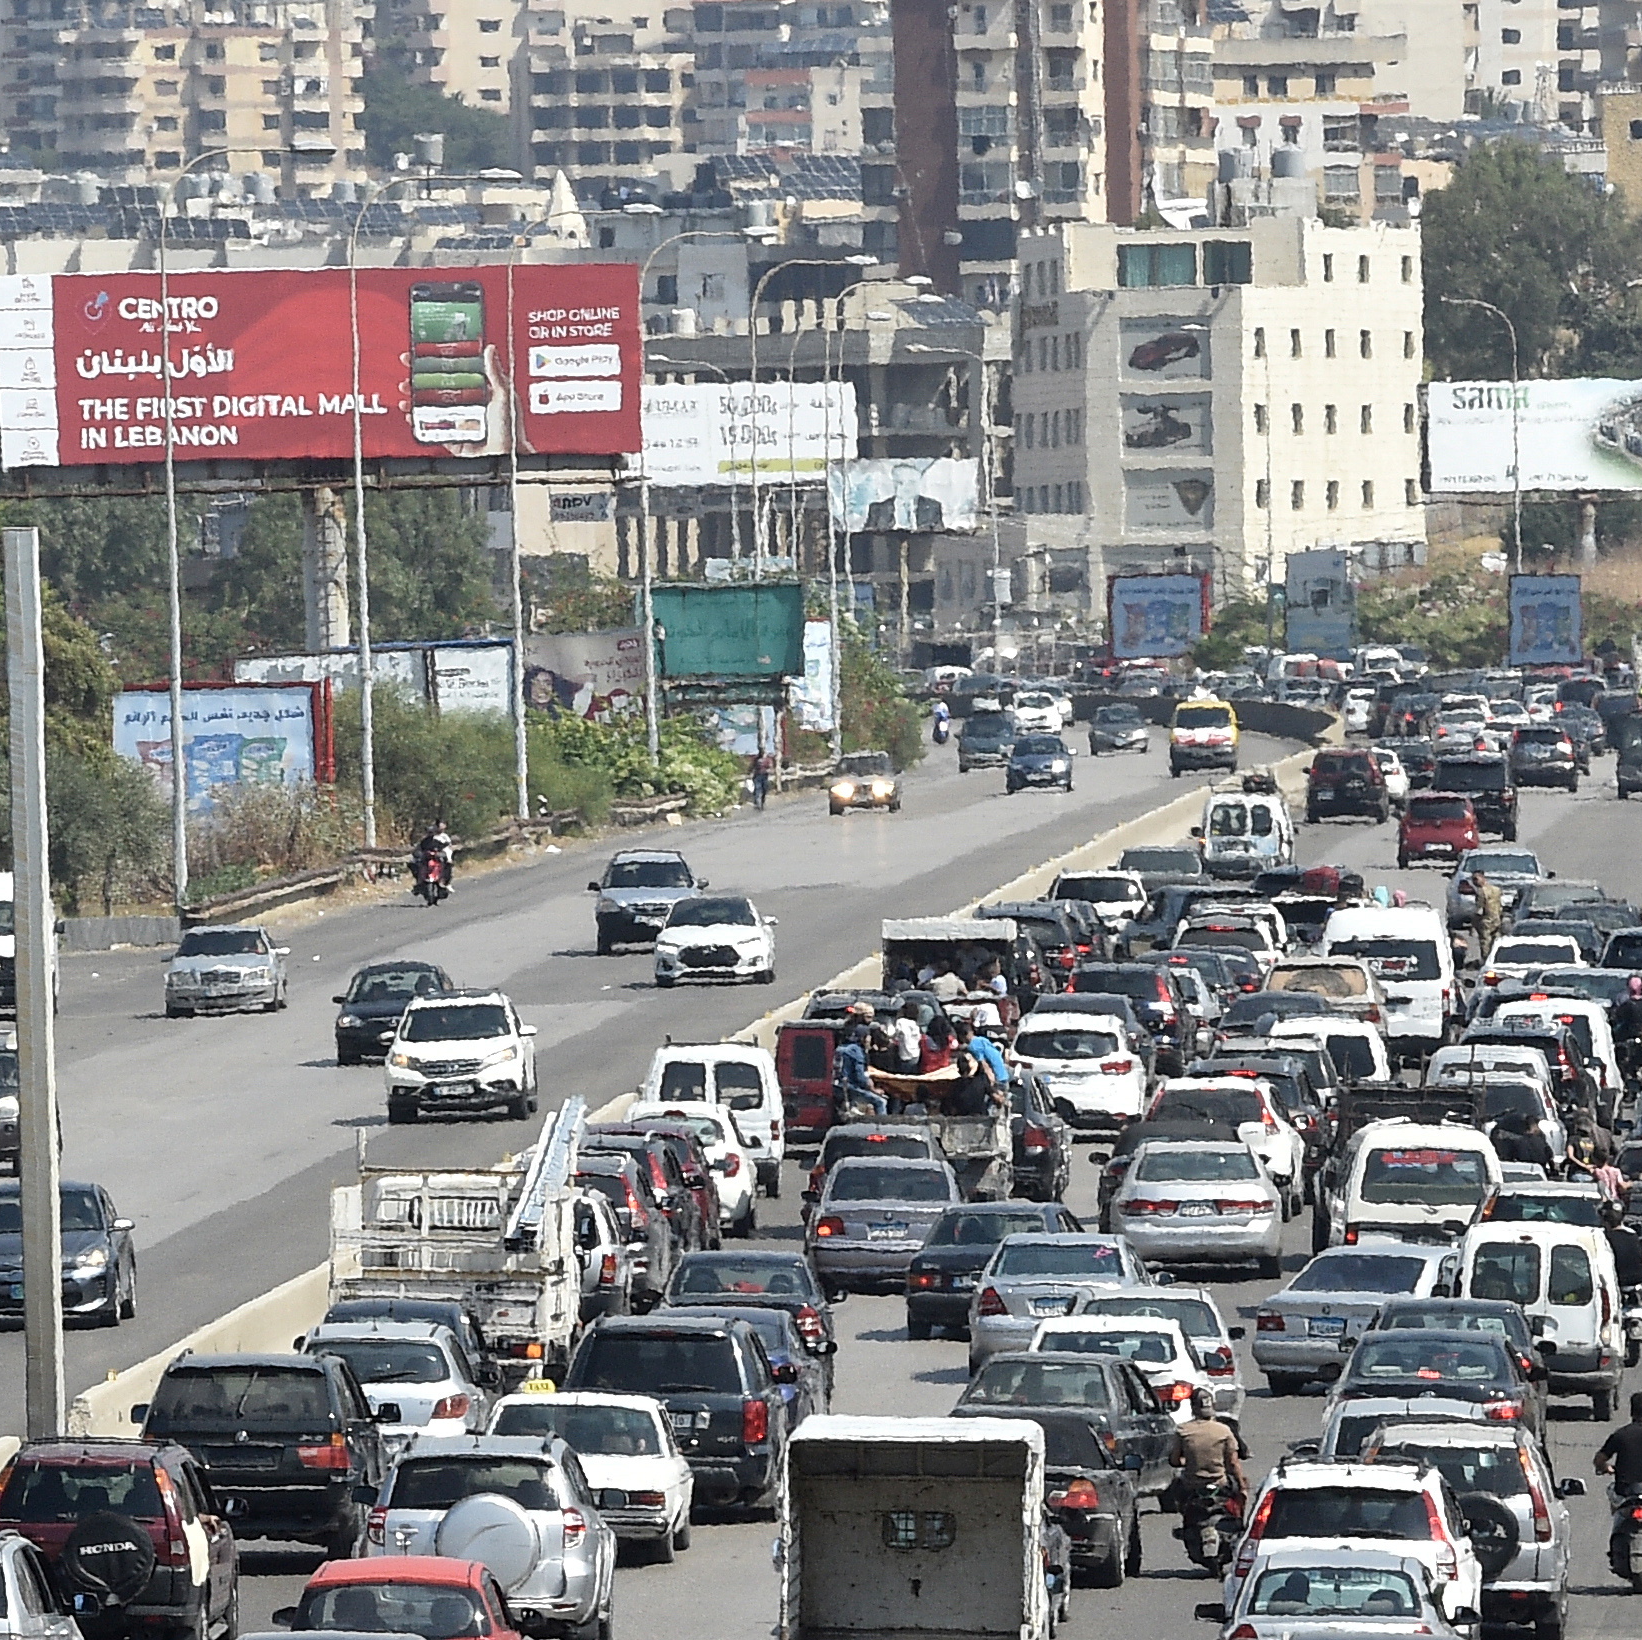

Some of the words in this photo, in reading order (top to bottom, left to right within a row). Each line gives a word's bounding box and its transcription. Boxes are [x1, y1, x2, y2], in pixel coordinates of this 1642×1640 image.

[118, 296, 219, 321] CENTRO
[528, 308, 566, 323] SHOP
[569, 306, 621, 321] ONLINE
[528, 325, 550, 339] OR
[551, 324, 568, 338] IN
[570, 322, 614, 337] STORE
[78, 398, 129, 421] THE
[136, 395, 208, 419] FIRST
[213, 393, 312, 418] DIGITAL
[318, 392, 389, 415] MALL
[80, 427, 107, 449] IN
[114, 424, 239, 448] LEBANON
[79, 1541, 138, 1556] HONDA
